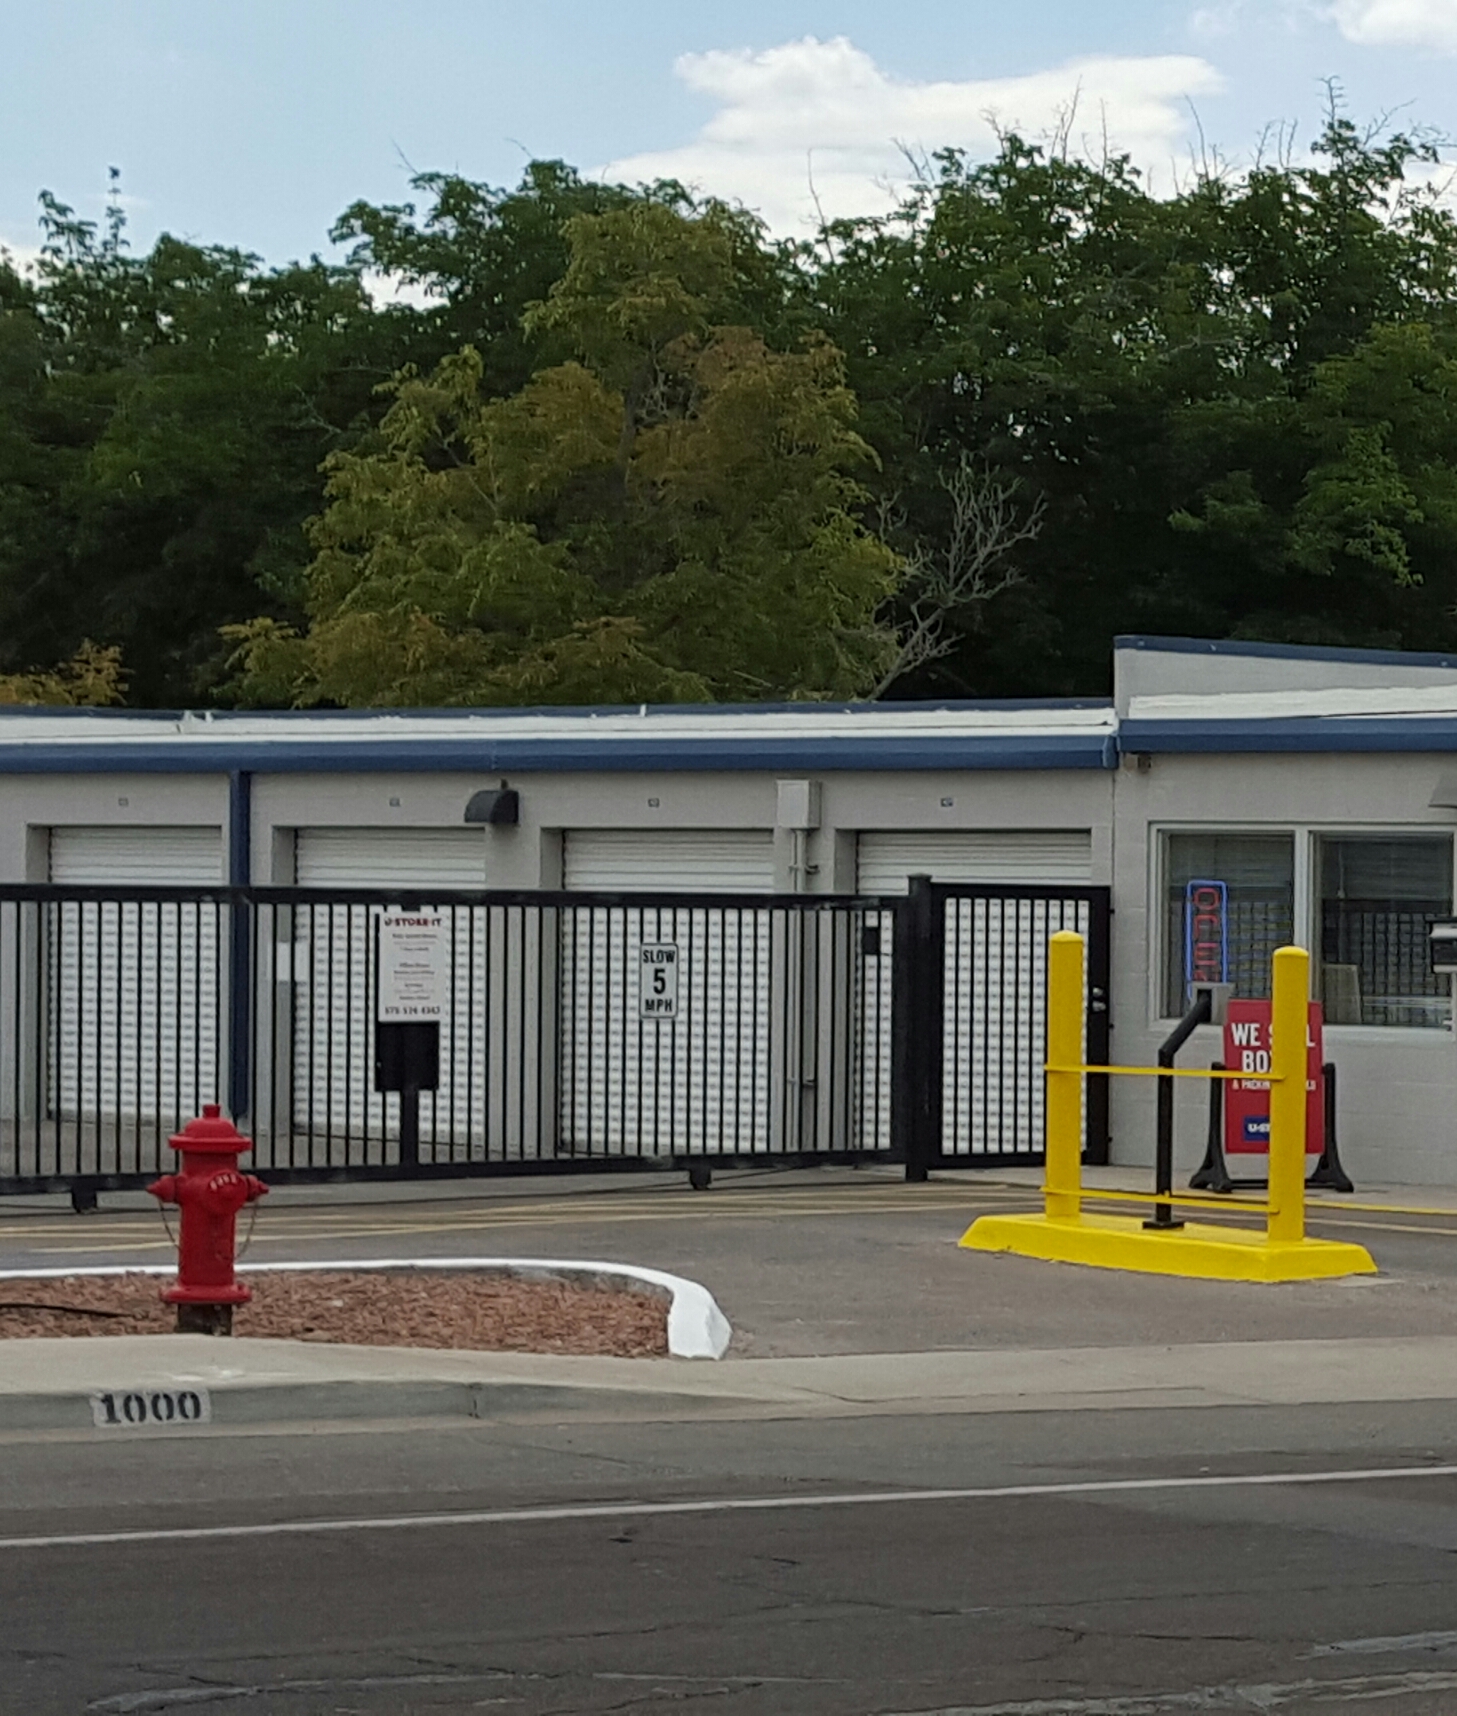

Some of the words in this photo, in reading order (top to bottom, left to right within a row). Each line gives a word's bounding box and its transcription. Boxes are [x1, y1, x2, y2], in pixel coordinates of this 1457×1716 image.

[643, 949, 676, 964] SLOW
[653, 967, 666, 995] 5
[644, 998, 673, 1012] MPH
[1231, 1022, 1262, 1047] WE
[100, 1390, 202, 1424] 1000
